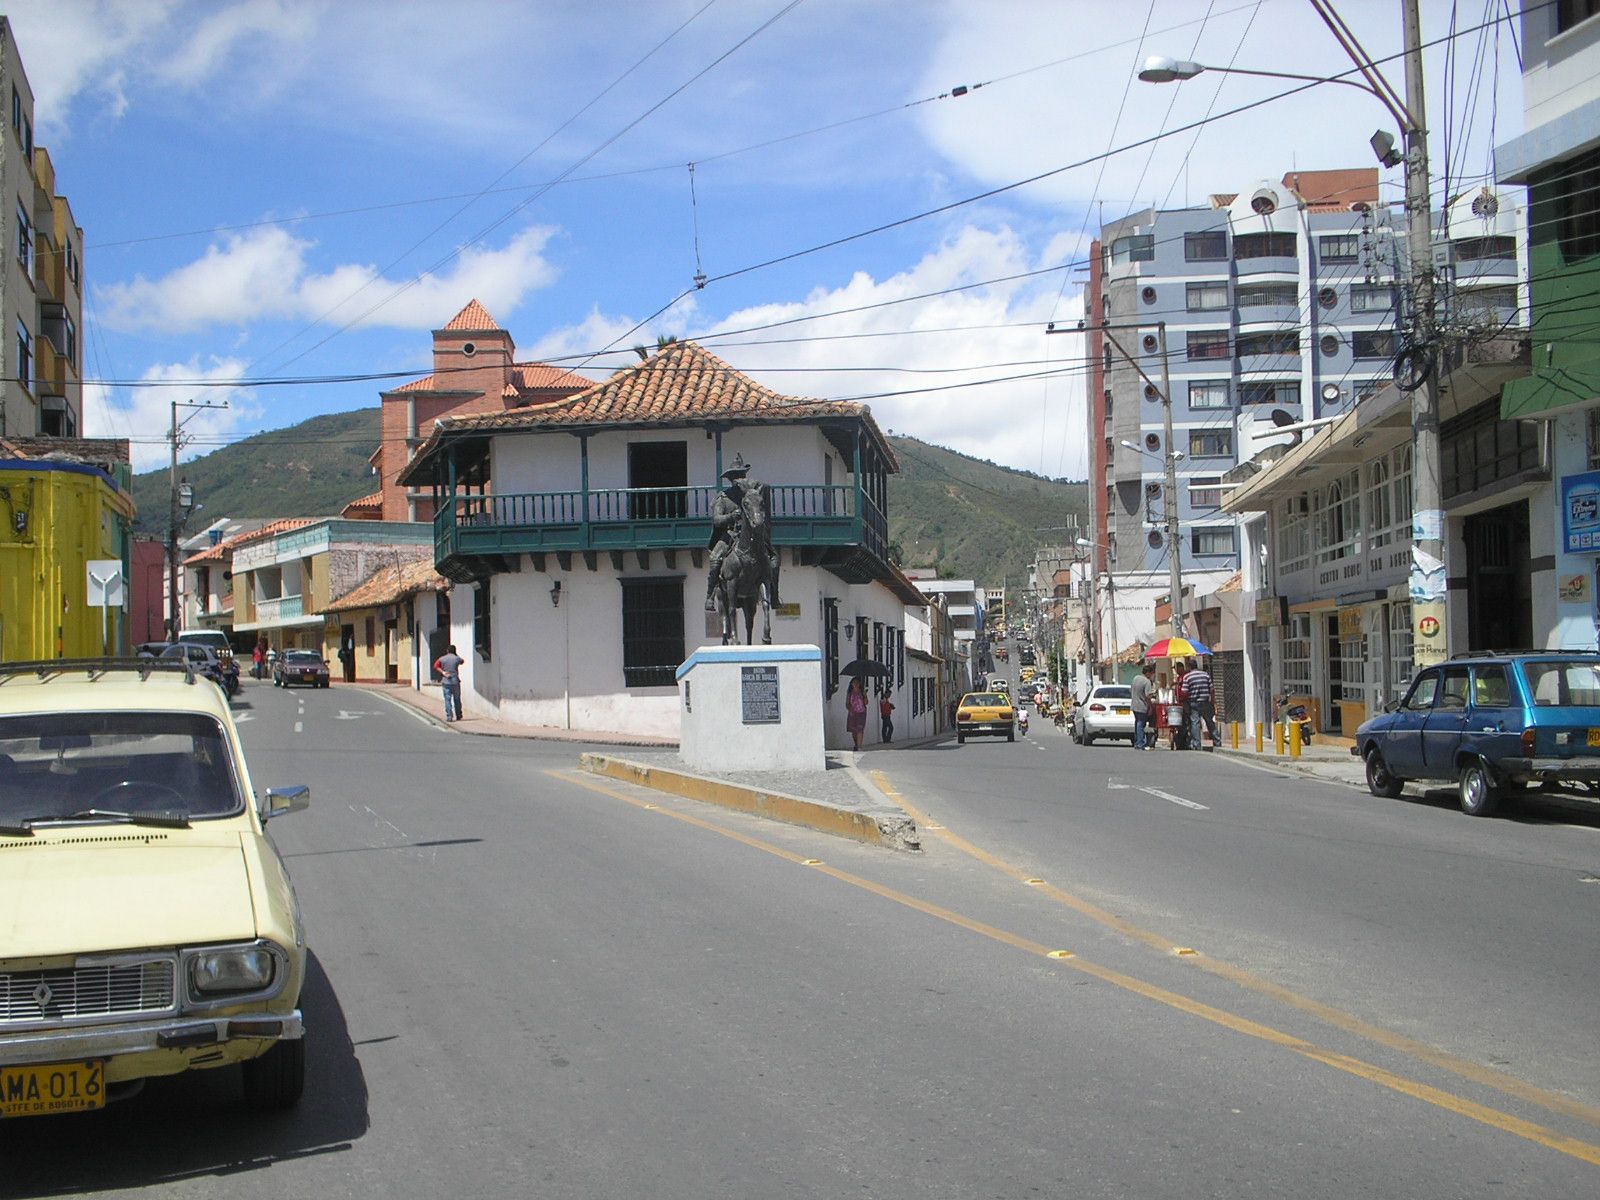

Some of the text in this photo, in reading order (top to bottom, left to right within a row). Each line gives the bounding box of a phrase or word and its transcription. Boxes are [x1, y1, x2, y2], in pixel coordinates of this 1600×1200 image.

[1389, 550, 1411, 568] AGUST
[33, 1101, 45, 1111] DE
[48, 1098, 86, 1110] BOGOTA
